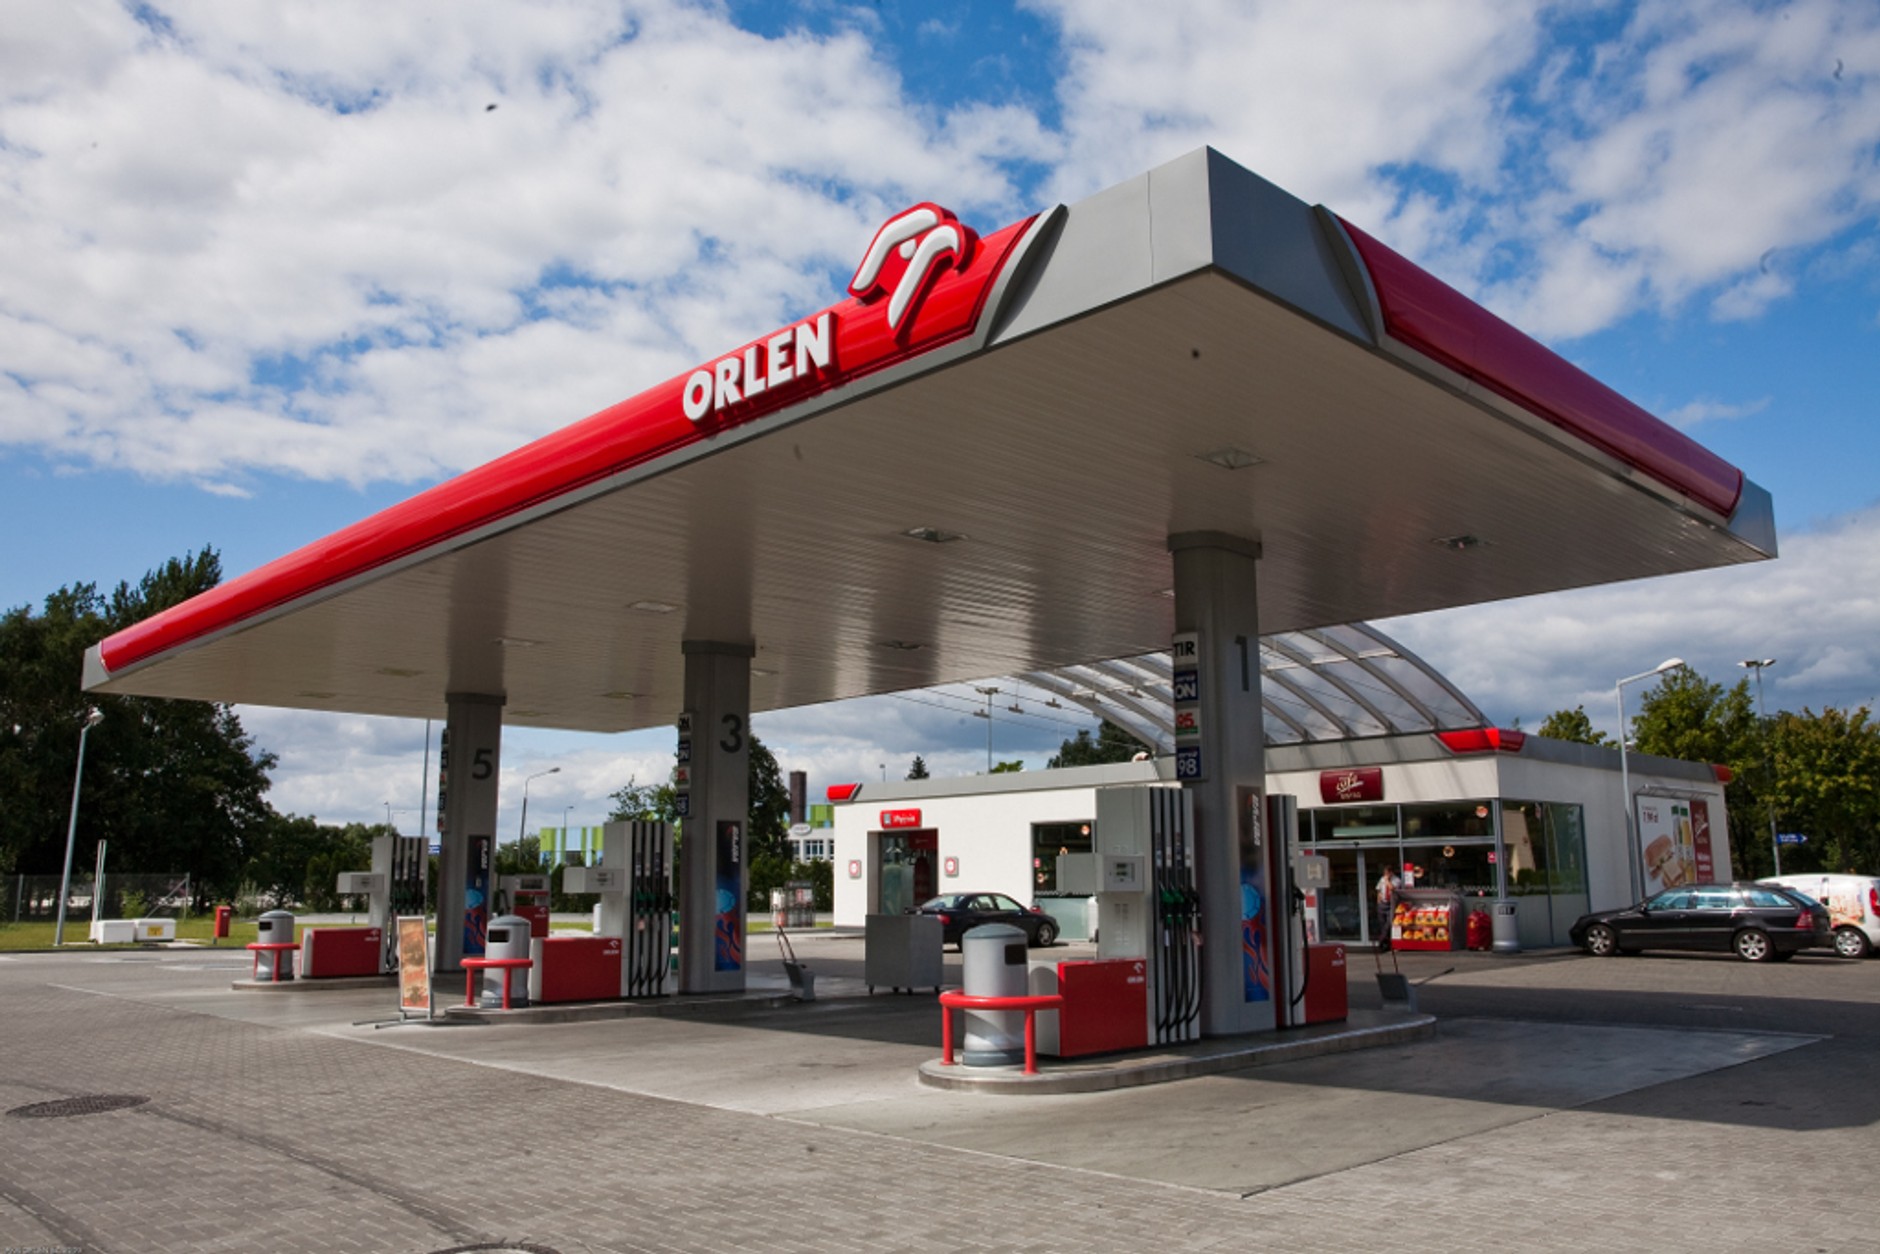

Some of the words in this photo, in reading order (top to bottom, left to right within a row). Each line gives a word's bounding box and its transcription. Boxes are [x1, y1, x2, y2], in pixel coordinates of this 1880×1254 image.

[682, 311, 831, 422] ORLEN
[1174, 640, 1195, 658] TIR
[1234, 634, 1250, 692] 1
[1175, 685, 1197, 700] ON
[720, 713, 743, 754] 3
[471, 748, 494, 781] 5
[1177, 757, 1198, 776] 98
